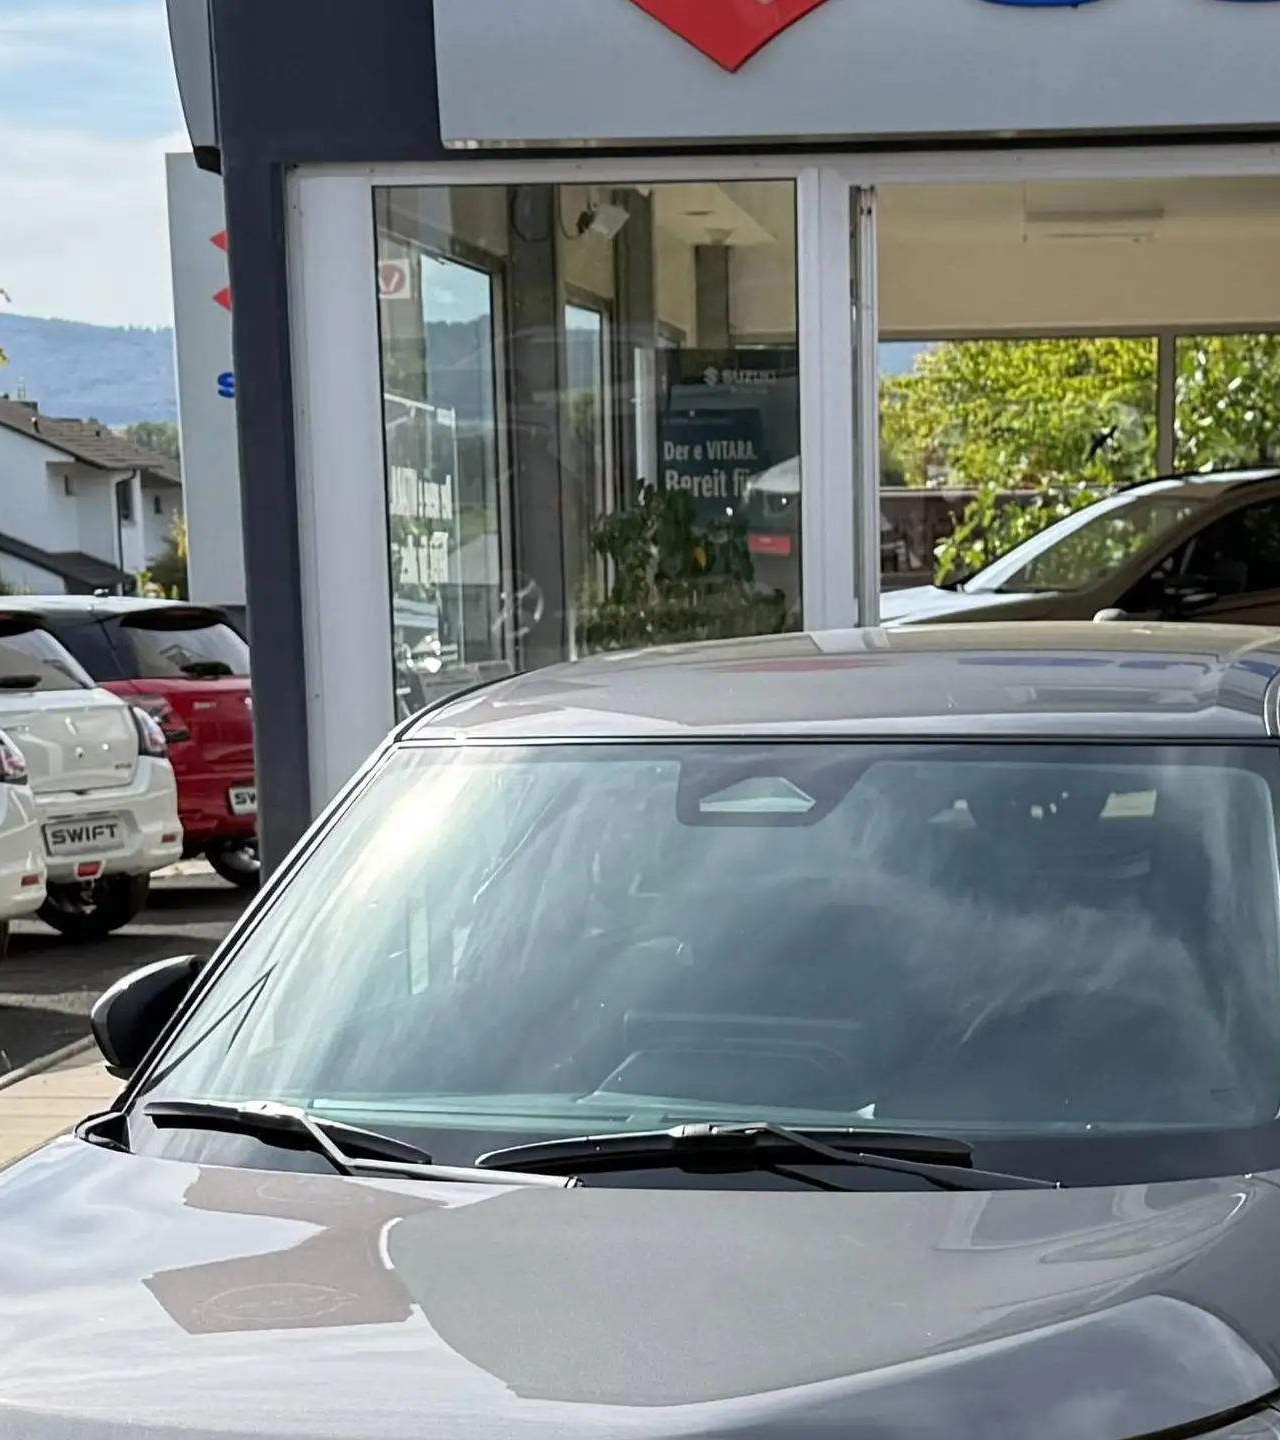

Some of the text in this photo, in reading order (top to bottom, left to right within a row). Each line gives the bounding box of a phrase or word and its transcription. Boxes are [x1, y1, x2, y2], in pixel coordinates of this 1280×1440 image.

[663, 440, 689, 461] Der
[693, 444, 703, 460] e
[50, 822, 118, 846] SWIFT
